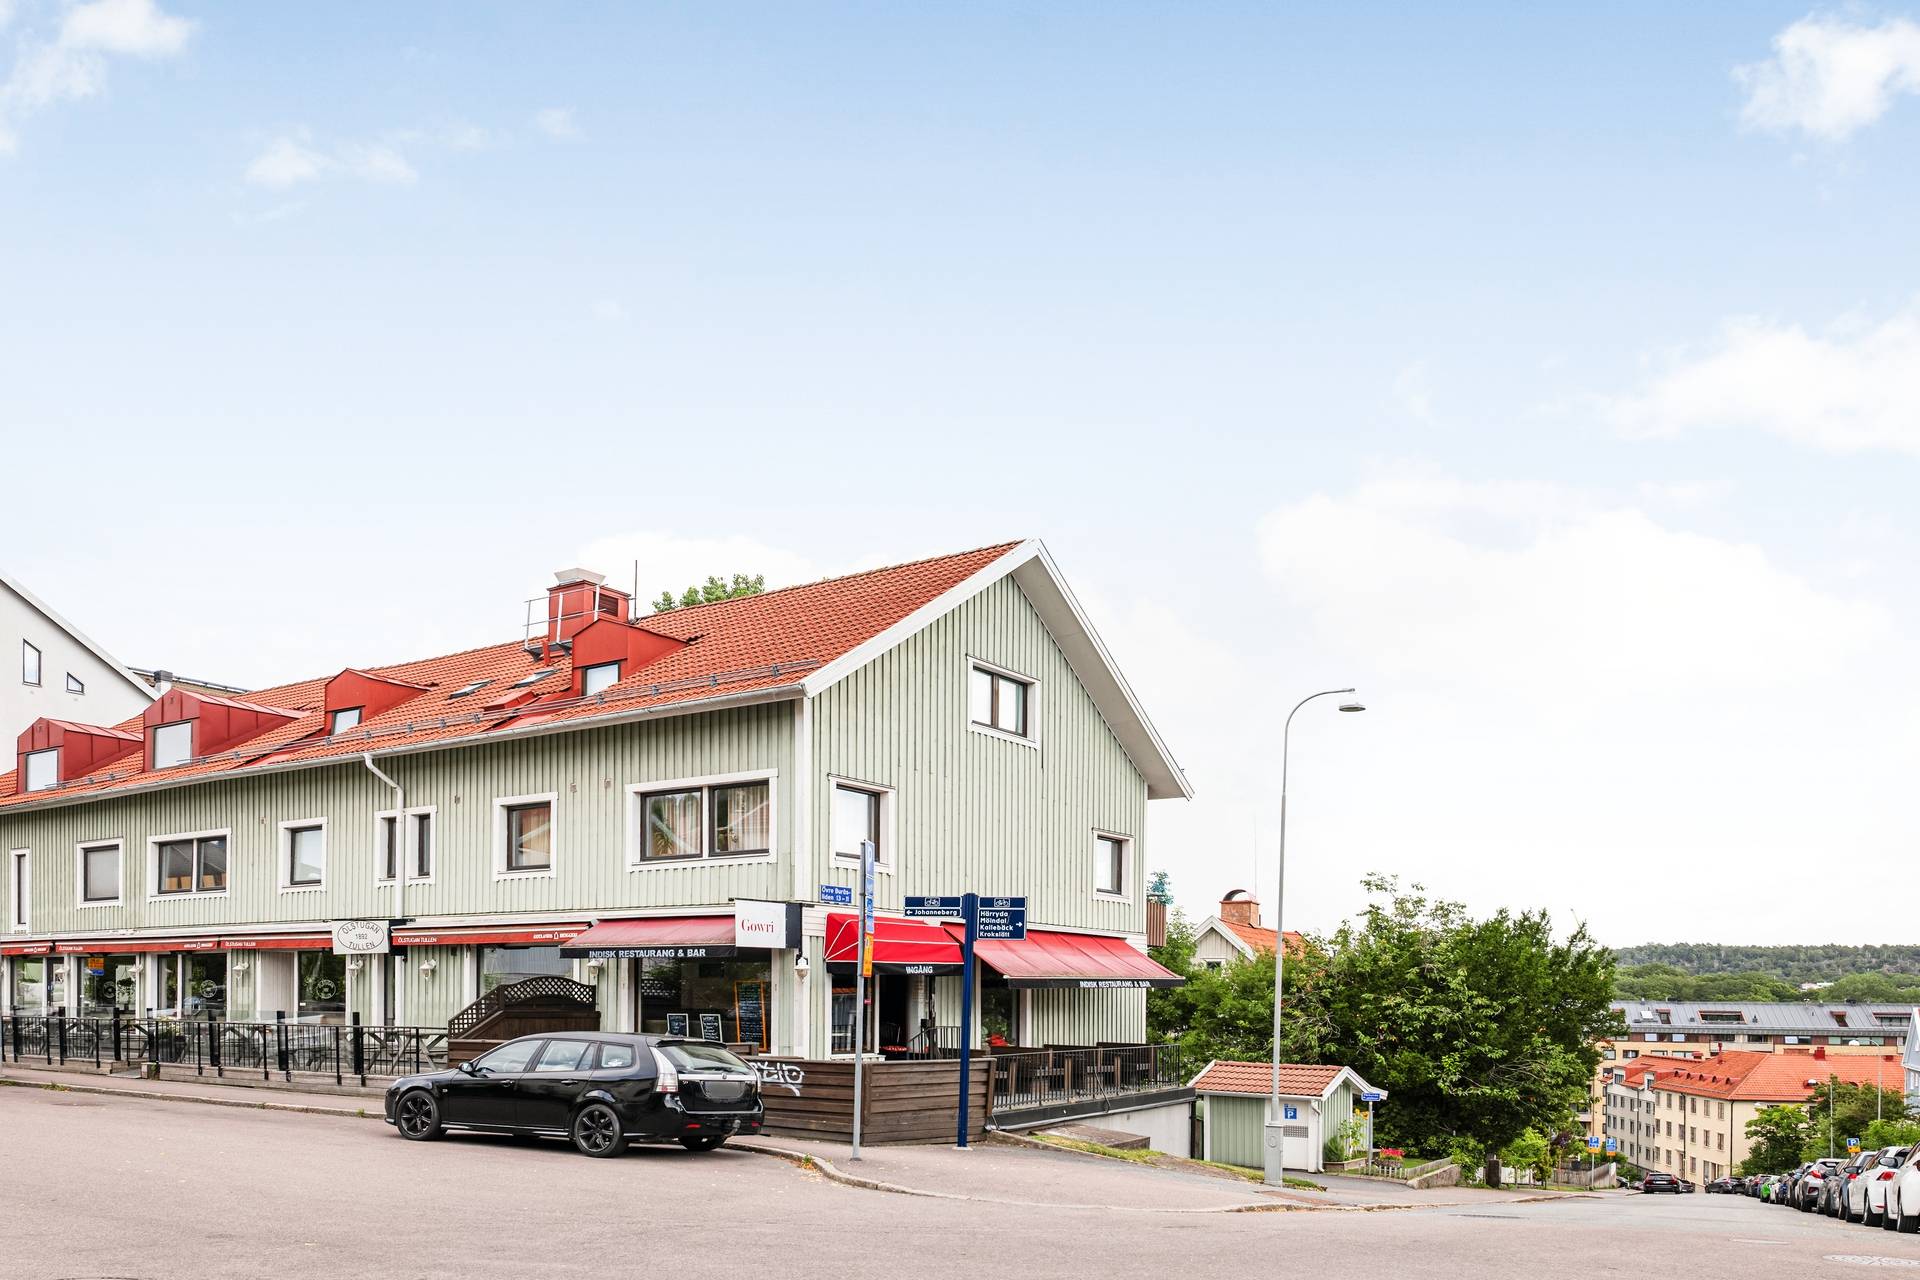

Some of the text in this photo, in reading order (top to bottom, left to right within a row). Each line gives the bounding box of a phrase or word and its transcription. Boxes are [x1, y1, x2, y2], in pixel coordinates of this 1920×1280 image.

[914, 908, 958, 916] Johanneberg
[980, 910, 1009, 918] Härryda
[741, 919, 774, 933] Gowri
[348, 941, 375, 950] TULLEN
[589, 948, 706, 958] INDISK RESTAURANG & BAR
[905, 965, 934, 974] INGÅNG
[1079, 980, 1098, 988] INDISK
[1098, 980, 1134, 988] RESTAURANG
[1287, 1110, 1294, 1119] P
